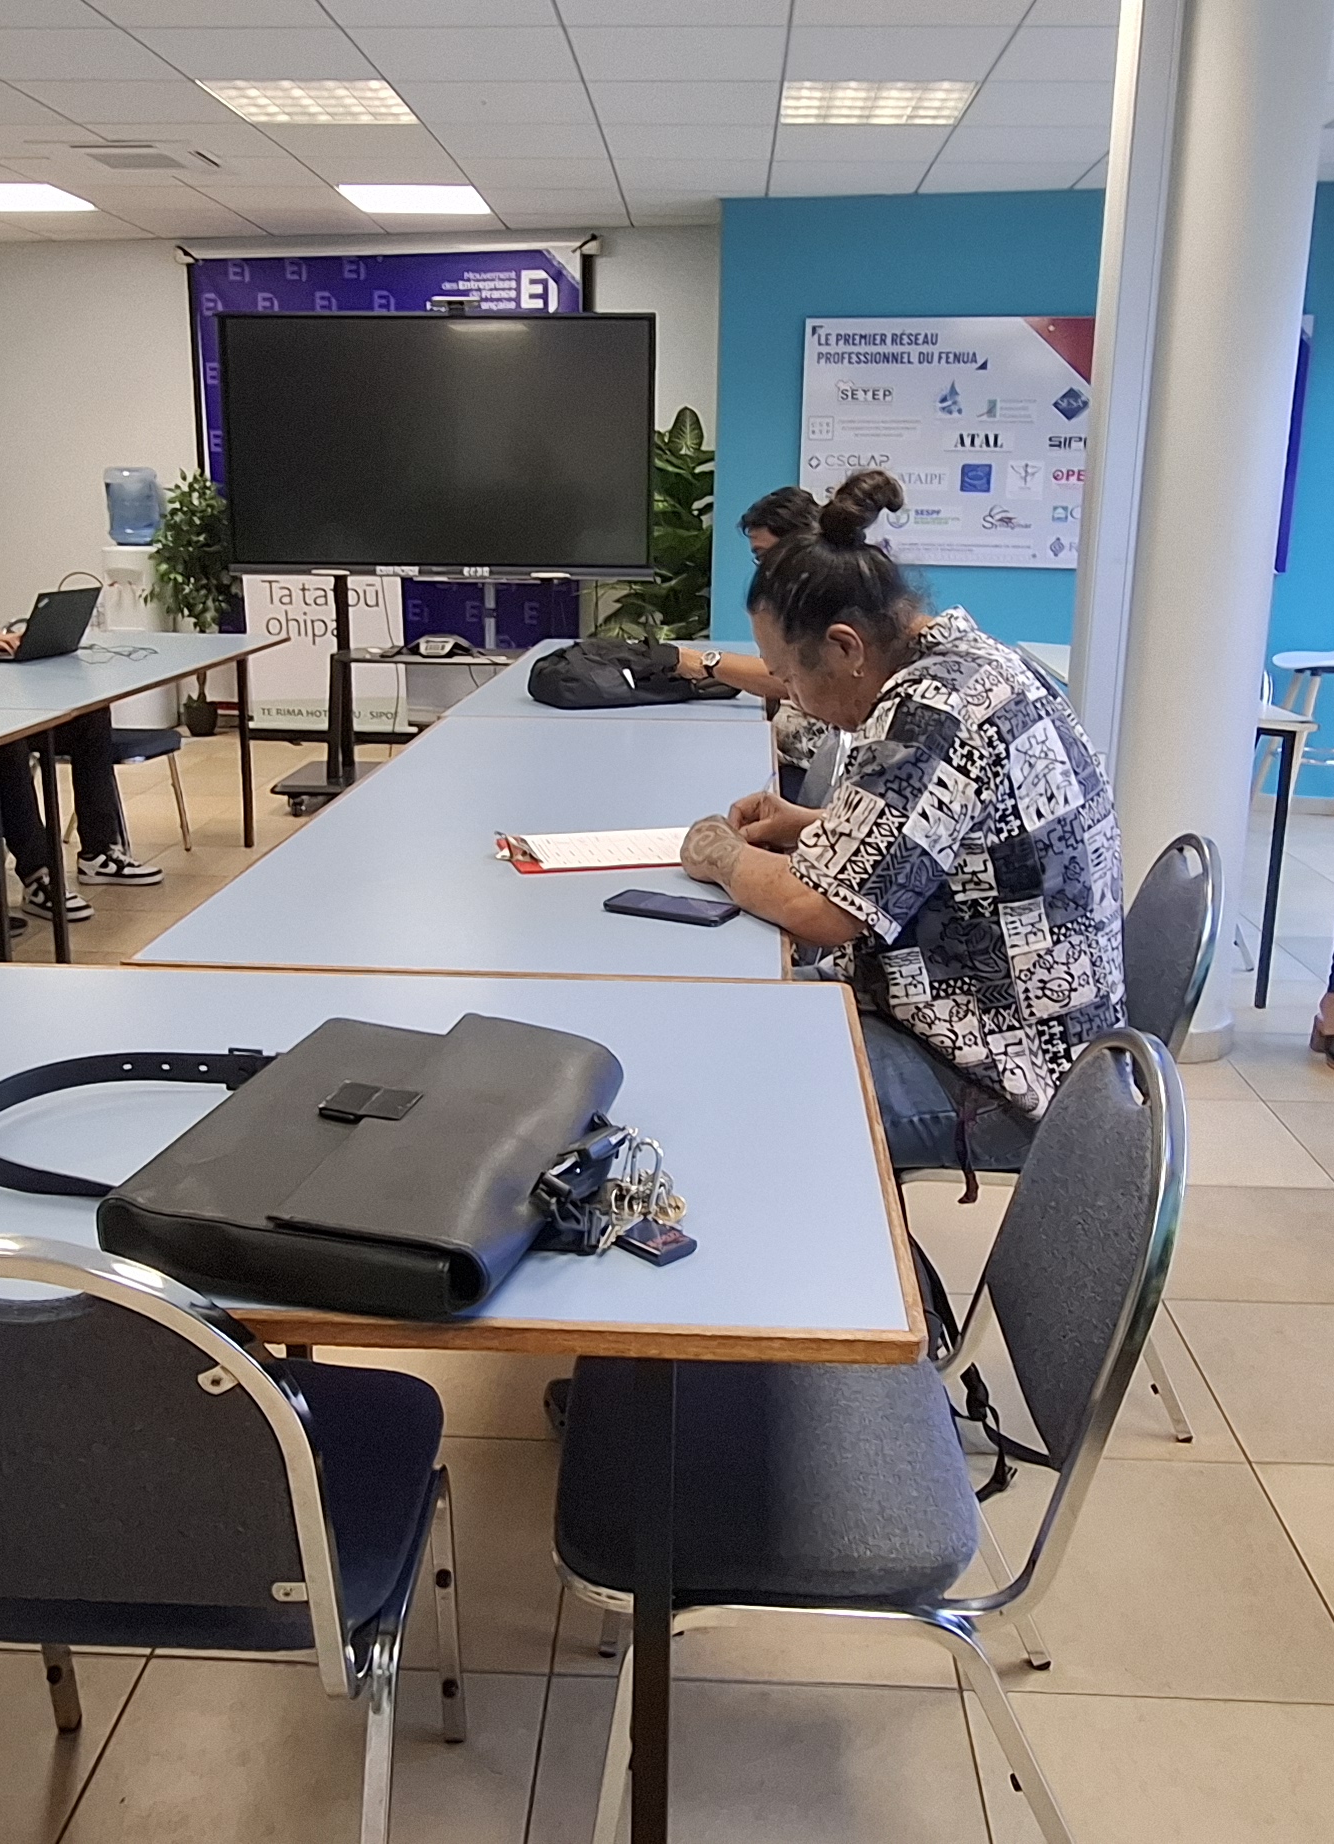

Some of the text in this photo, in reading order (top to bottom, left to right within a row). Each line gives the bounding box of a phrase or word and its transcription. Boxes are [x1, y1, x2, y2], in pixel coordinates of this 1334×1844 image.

[458, 280, 516, 290] Entreprises
[481, 290, 516, 298] France
[480, 301, 516, 310] ançaise
[817, 330, 938, 346] LE PREMIER RÉSEAU
[817, 351, 978, 365] PROFESSIONNEL DU FENUA
[954, 433, 1004, 448] ATAL
[825, 454, 890, 467] CSCLAP
[261, 580, 293, 605] Ta
[261, 708, 274, 717] TE
[276, 708, 304, 717] RIMA
